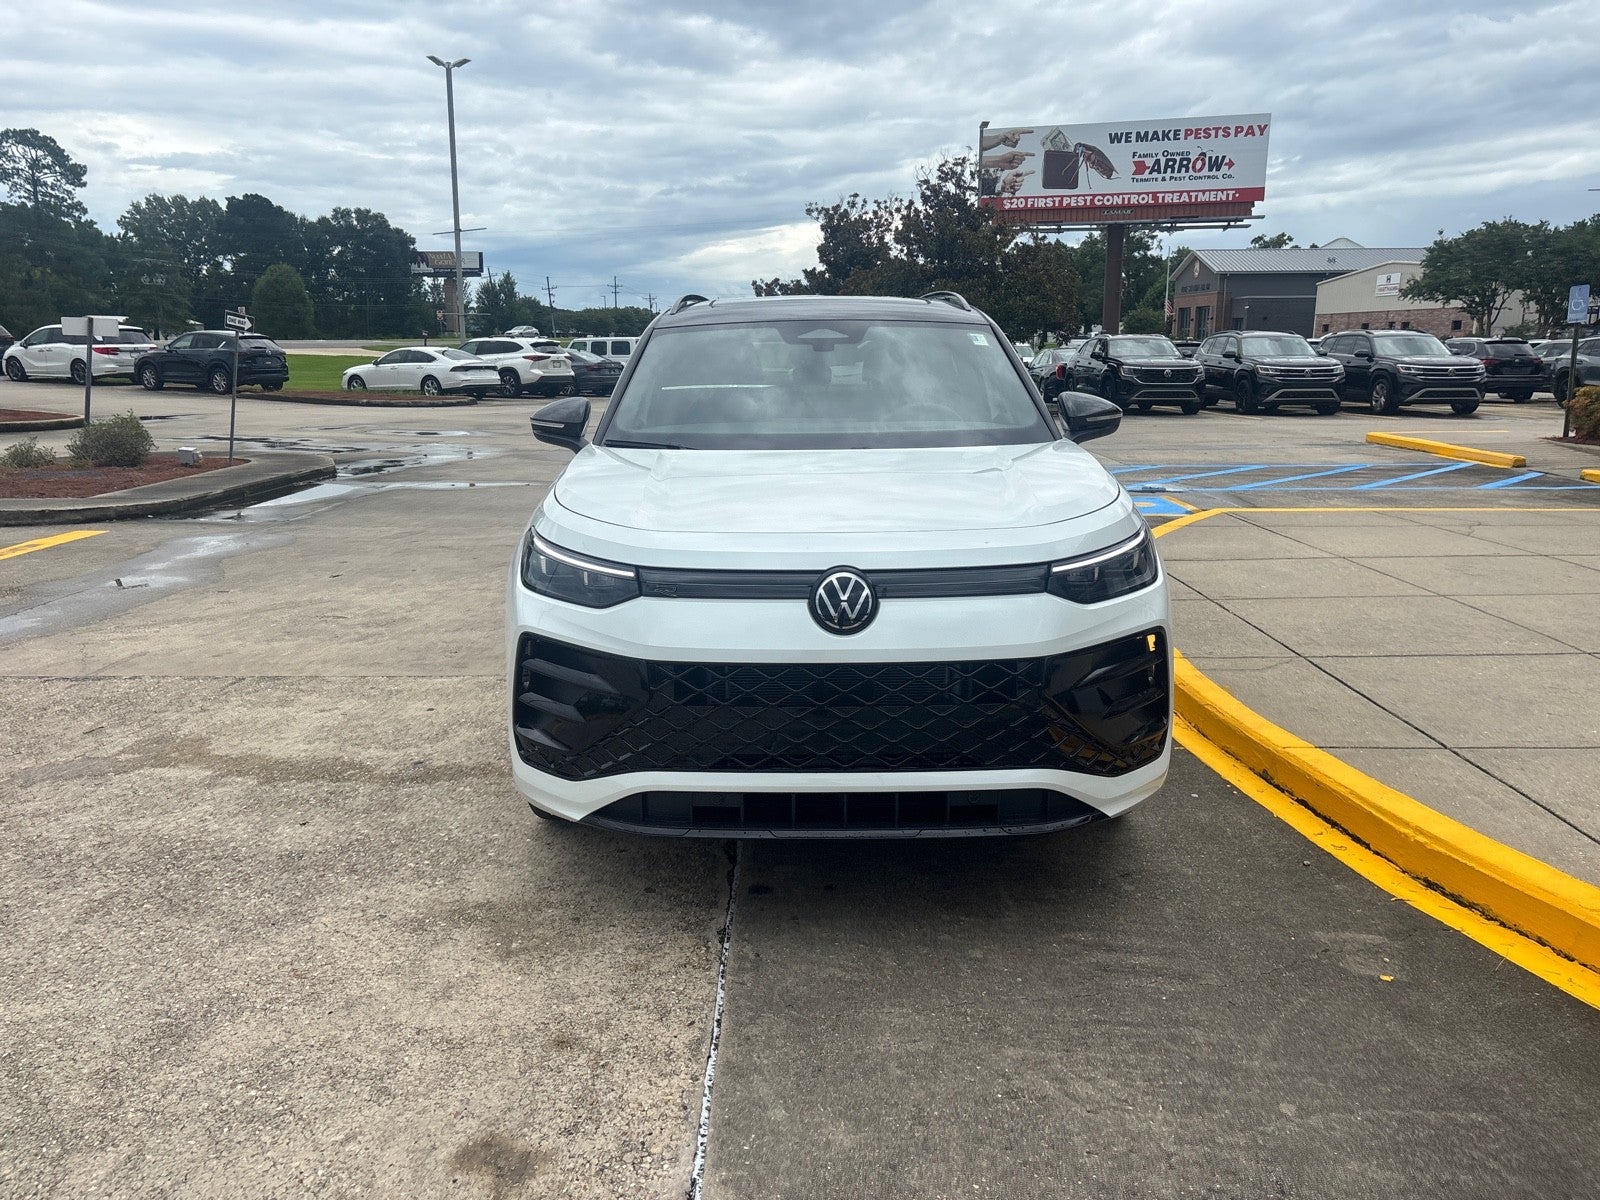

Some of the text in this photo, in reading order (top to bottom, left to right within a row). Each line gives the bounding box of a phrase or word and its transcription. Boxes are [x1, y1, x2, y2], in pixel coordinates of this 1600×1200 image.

[1109, 124, 1268, 144] WE MAKE PESTS PAY
[1148, 155, 1226, 175] ARROW
[1003, 199, 1026, 209] $20
[1027, 196, 1060, 208] FIRST
[1062, 195, 1093, 206] PEST
[1094, 193, 1155, 206] CONTROL
[228, 316, 237, 324] ONE
[815, 571, 872, 629] VW
